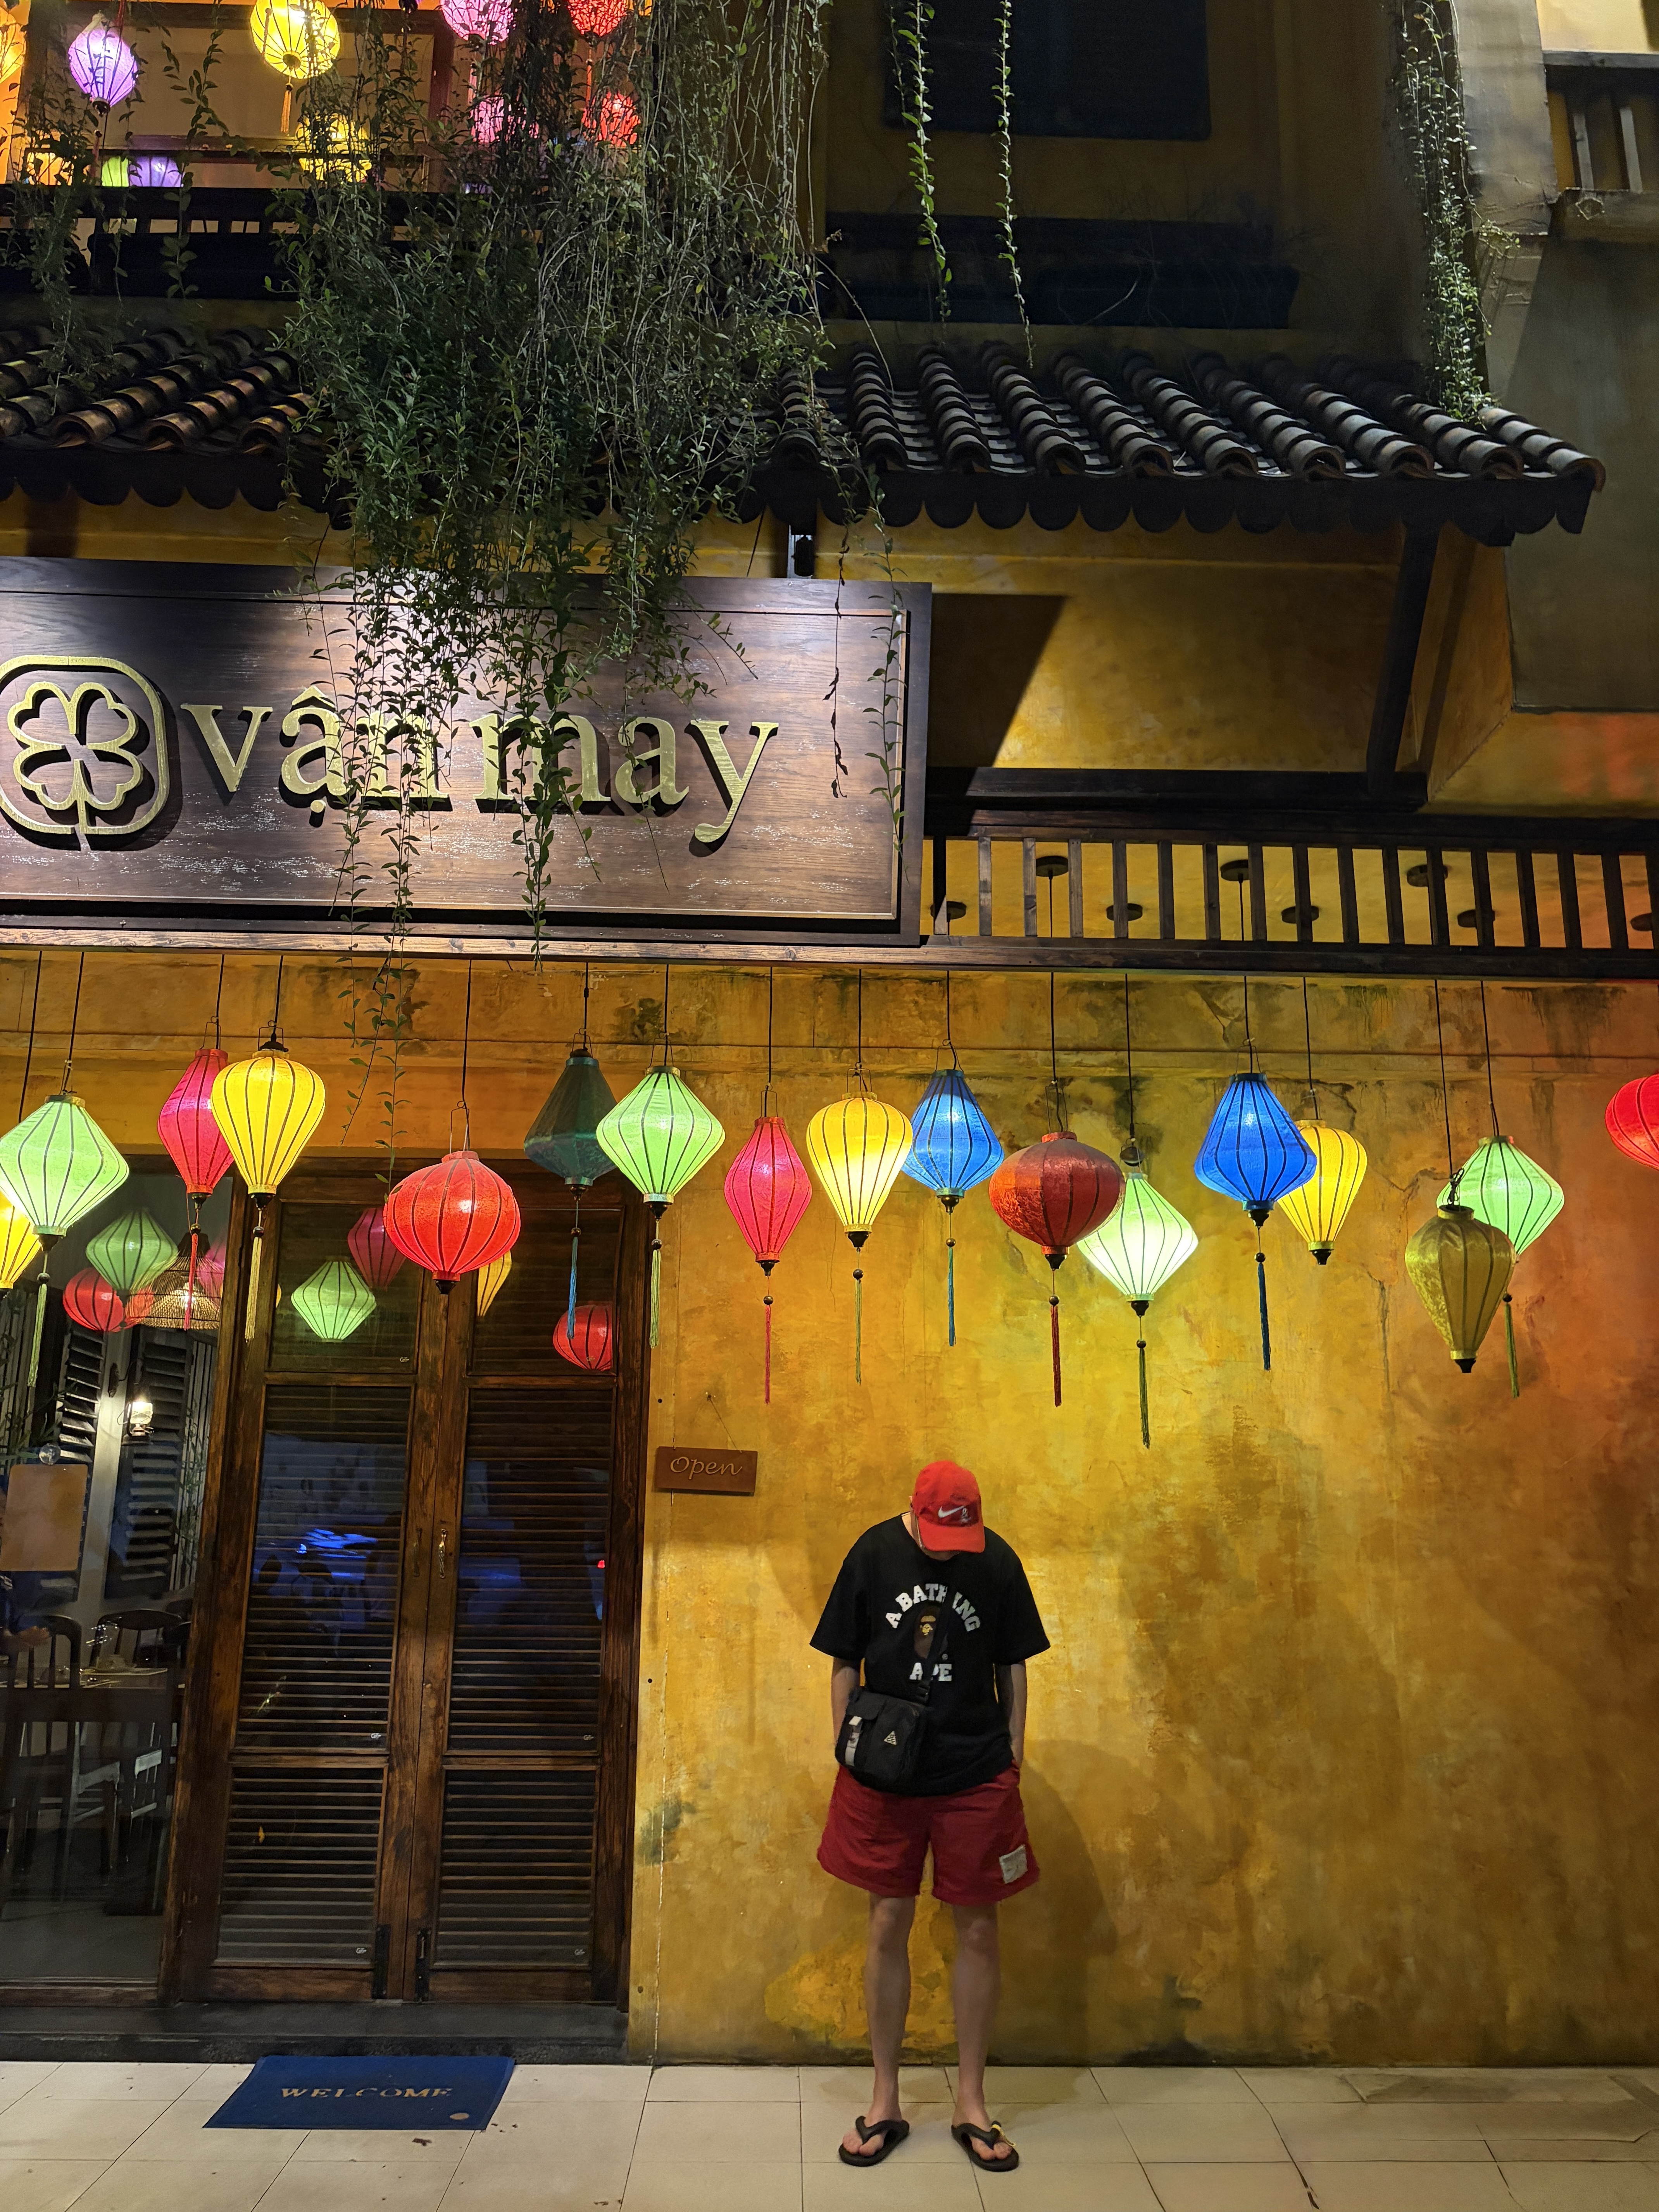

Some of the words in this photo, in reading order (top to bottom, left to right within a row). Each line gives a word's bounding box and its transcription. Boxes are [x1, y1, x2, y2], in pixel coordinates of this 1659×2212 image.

[469, 713, 779, 843] may
[670, 1456, 743, 1480] Open
[885, 1612, 902, 1629] A
[281, 2088, 453, 2098] WELCOME
